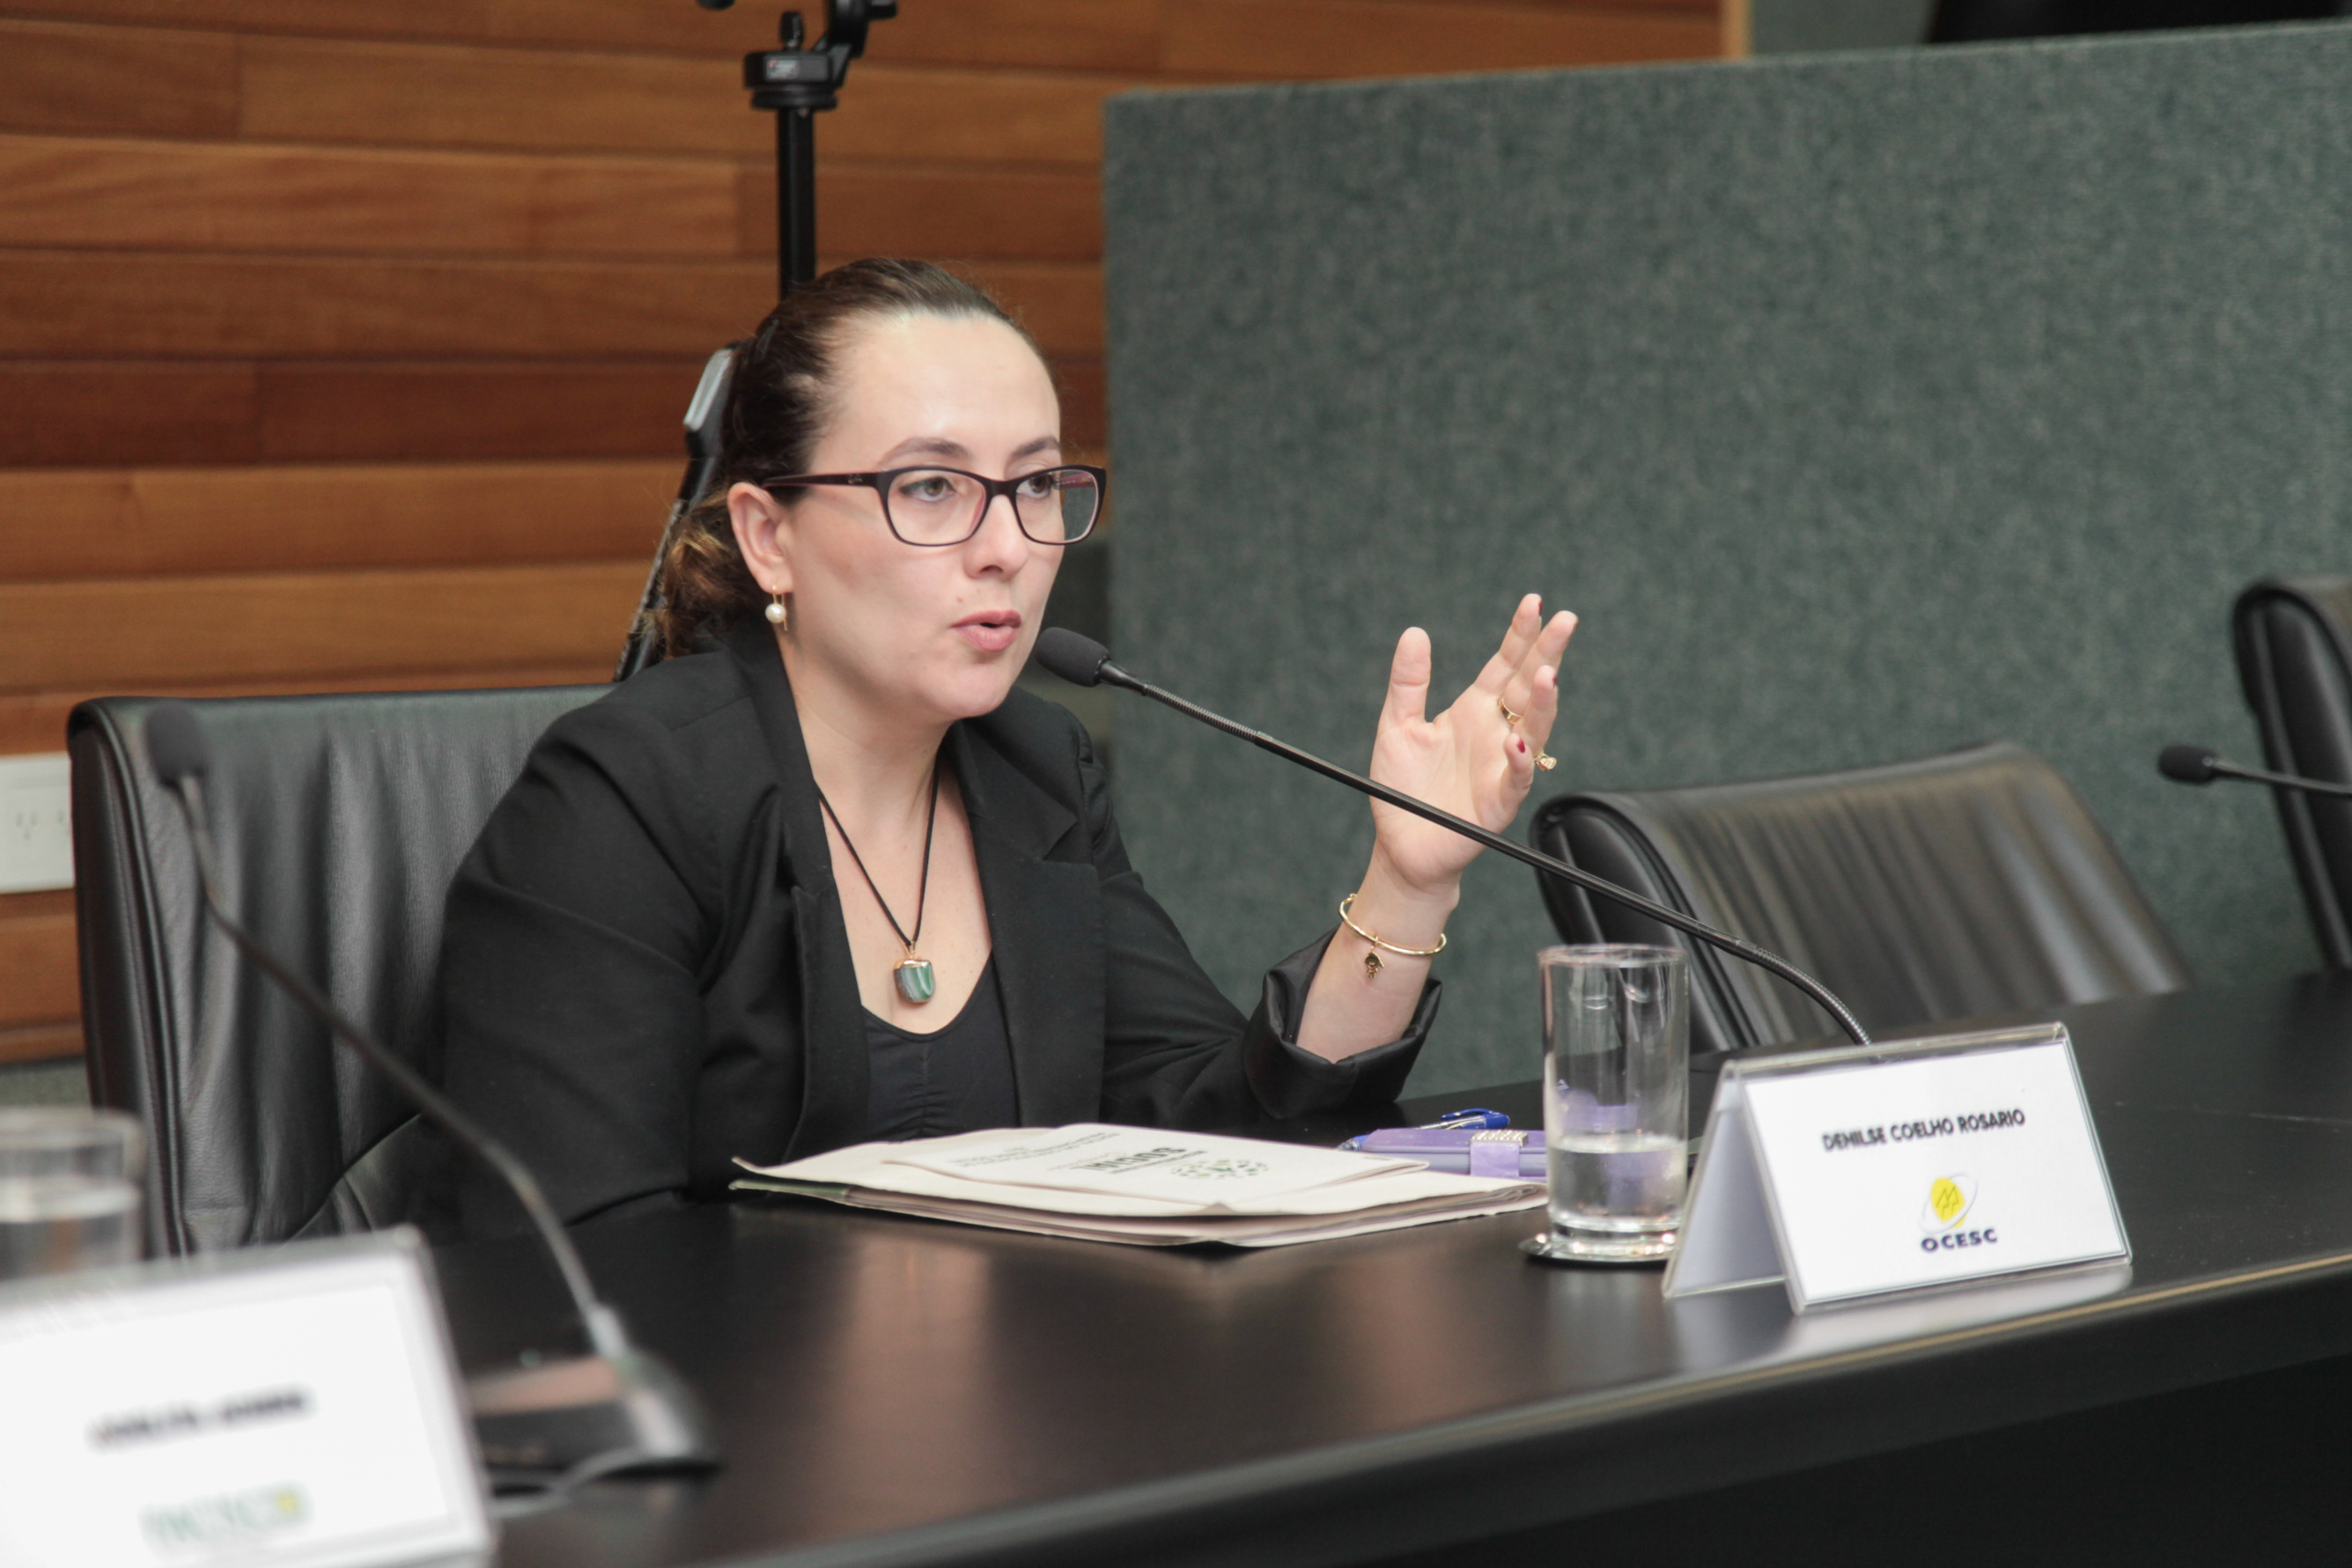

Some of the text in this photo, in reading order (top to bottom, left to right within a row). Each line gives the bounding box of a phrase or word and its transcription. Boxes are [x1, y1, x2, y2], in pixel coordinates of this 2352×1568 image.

[1891, 1118, 1953, 1141] COELHO
[1958, 1109, 2025, 1133] ROSARIO
[1921, 1228, 1998, 1252] OCESC
